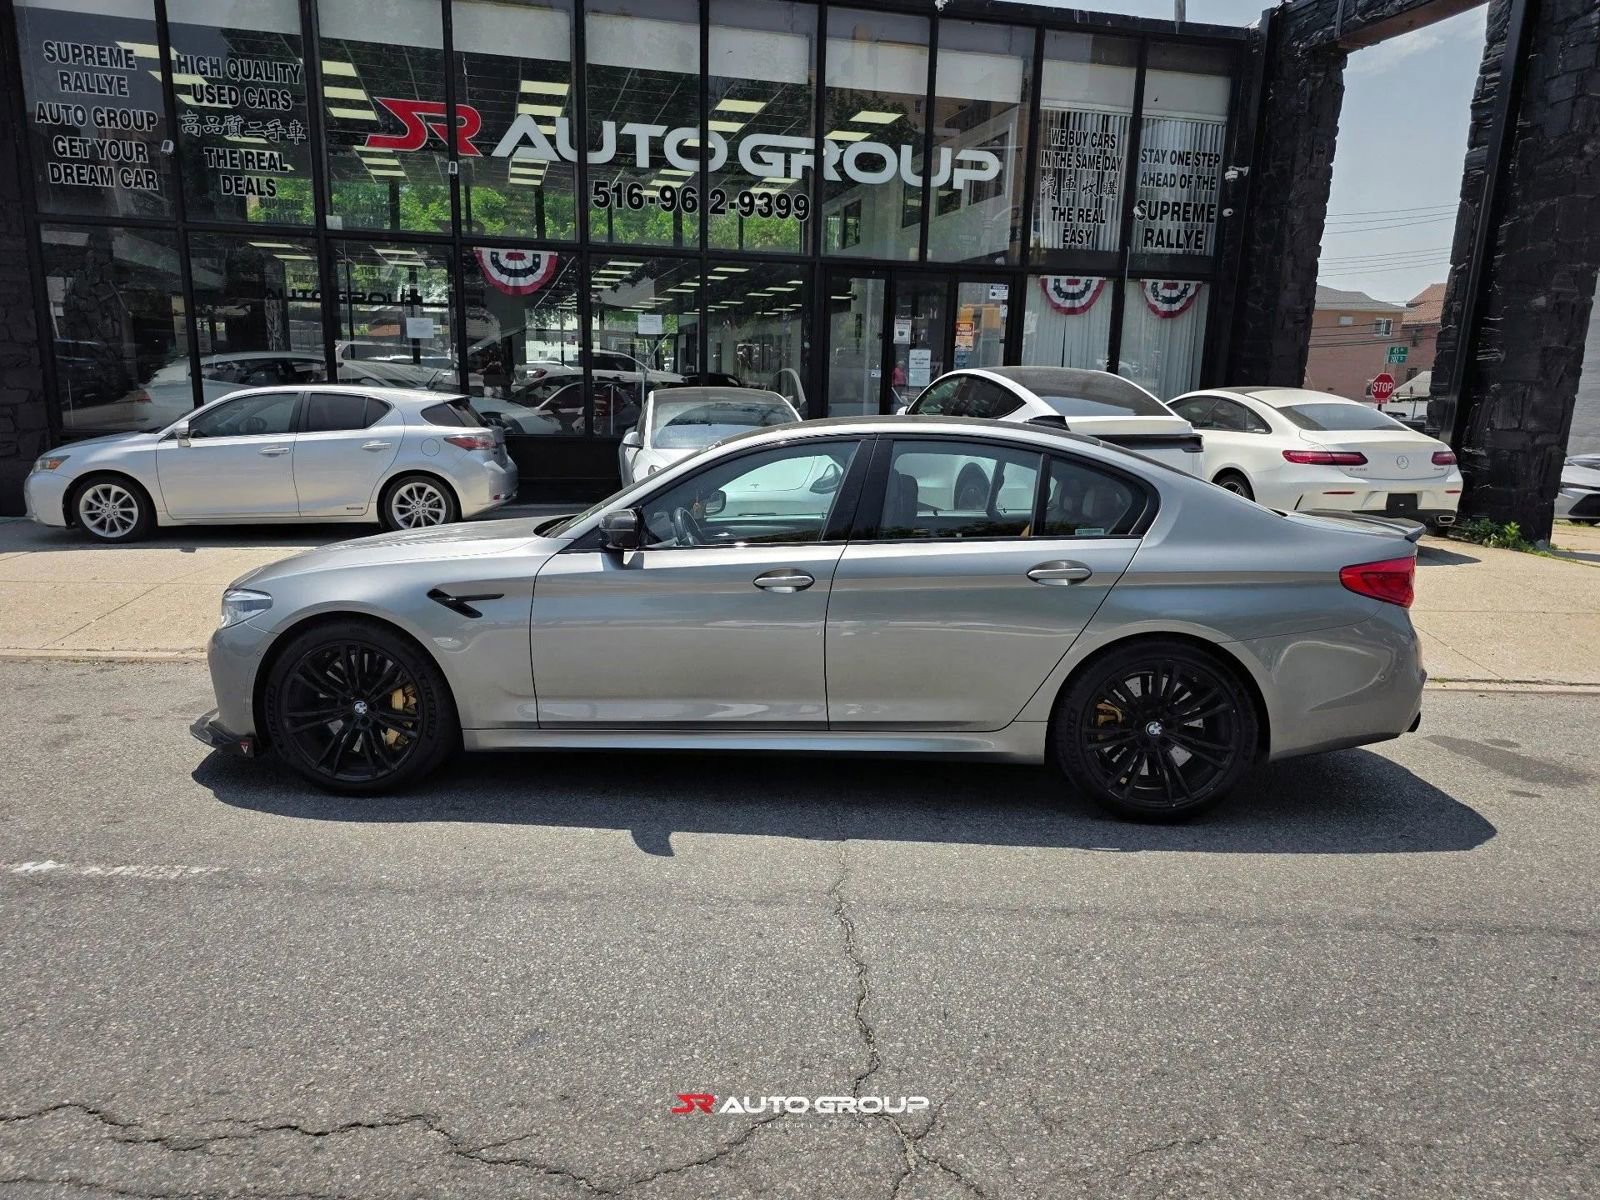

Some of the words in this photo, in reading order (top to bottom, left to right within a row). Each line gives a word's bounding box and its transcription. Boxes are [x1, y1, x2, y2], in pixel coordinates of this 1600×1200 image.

[43, 40, 137, 70] SUPREME
[175, 54, 222, 78] HIGH
[226, 58, 301, 84] QUALITY
[58, 70, 129, 98] RALLYE
[191, 83, 240, 107] USED
[244, 87, 292, 111] CARS
[35, 102, 87, 126] AUTO
[92, 106, 158, 132] GROUP
[181, 109, 306, 145] 高品質二手車
[53, 135, 91, 159] GET
[95, 138, 149, 163] YOUR
[491, 113, 728, 172] AUTO
[738, 133, 1000, 190] GROUP
[1051, 128, 1066, 146] WE
[1068, 130, 1089, 147] BUY
[1090, 132, 1117, 150] CARS
[203, 147, 240, 169] THE
[244, 150, 289, 173] REAL
[1040, 150, 1052, 168] IN
[1054, 151, 1073, 169] THE
[1074, 153, 1102, 171] SAME
[1103, 155, 1123, 173] DAY
[1140, 148, 1167, 164] STAY
[1169, 150, 1192, 167] ONE
[1193, 151, 1220, 168] STEP
[48, 162, 115, 187] DREAM
[119, 167, 158, 190] CAR
[220, 174, 277, 199] DEALS
[1140, 171, 1176, 188] AHEAD
[1179, 173, 1193, 189] OF
[1196, 175, 1217, 191] THE
[592, 180, 810, 221] 516-962-9399
[1135, 199, 1217, 223] SUPREME
[1051, 206, 1074, 223] THE
[1077, 208, 1106, 225] REAL
[1062, 228, 1092, 245] EASY
[1142, 227, 1205, 250] RALLYE
[1372, 382, 1393, 393] STOP
